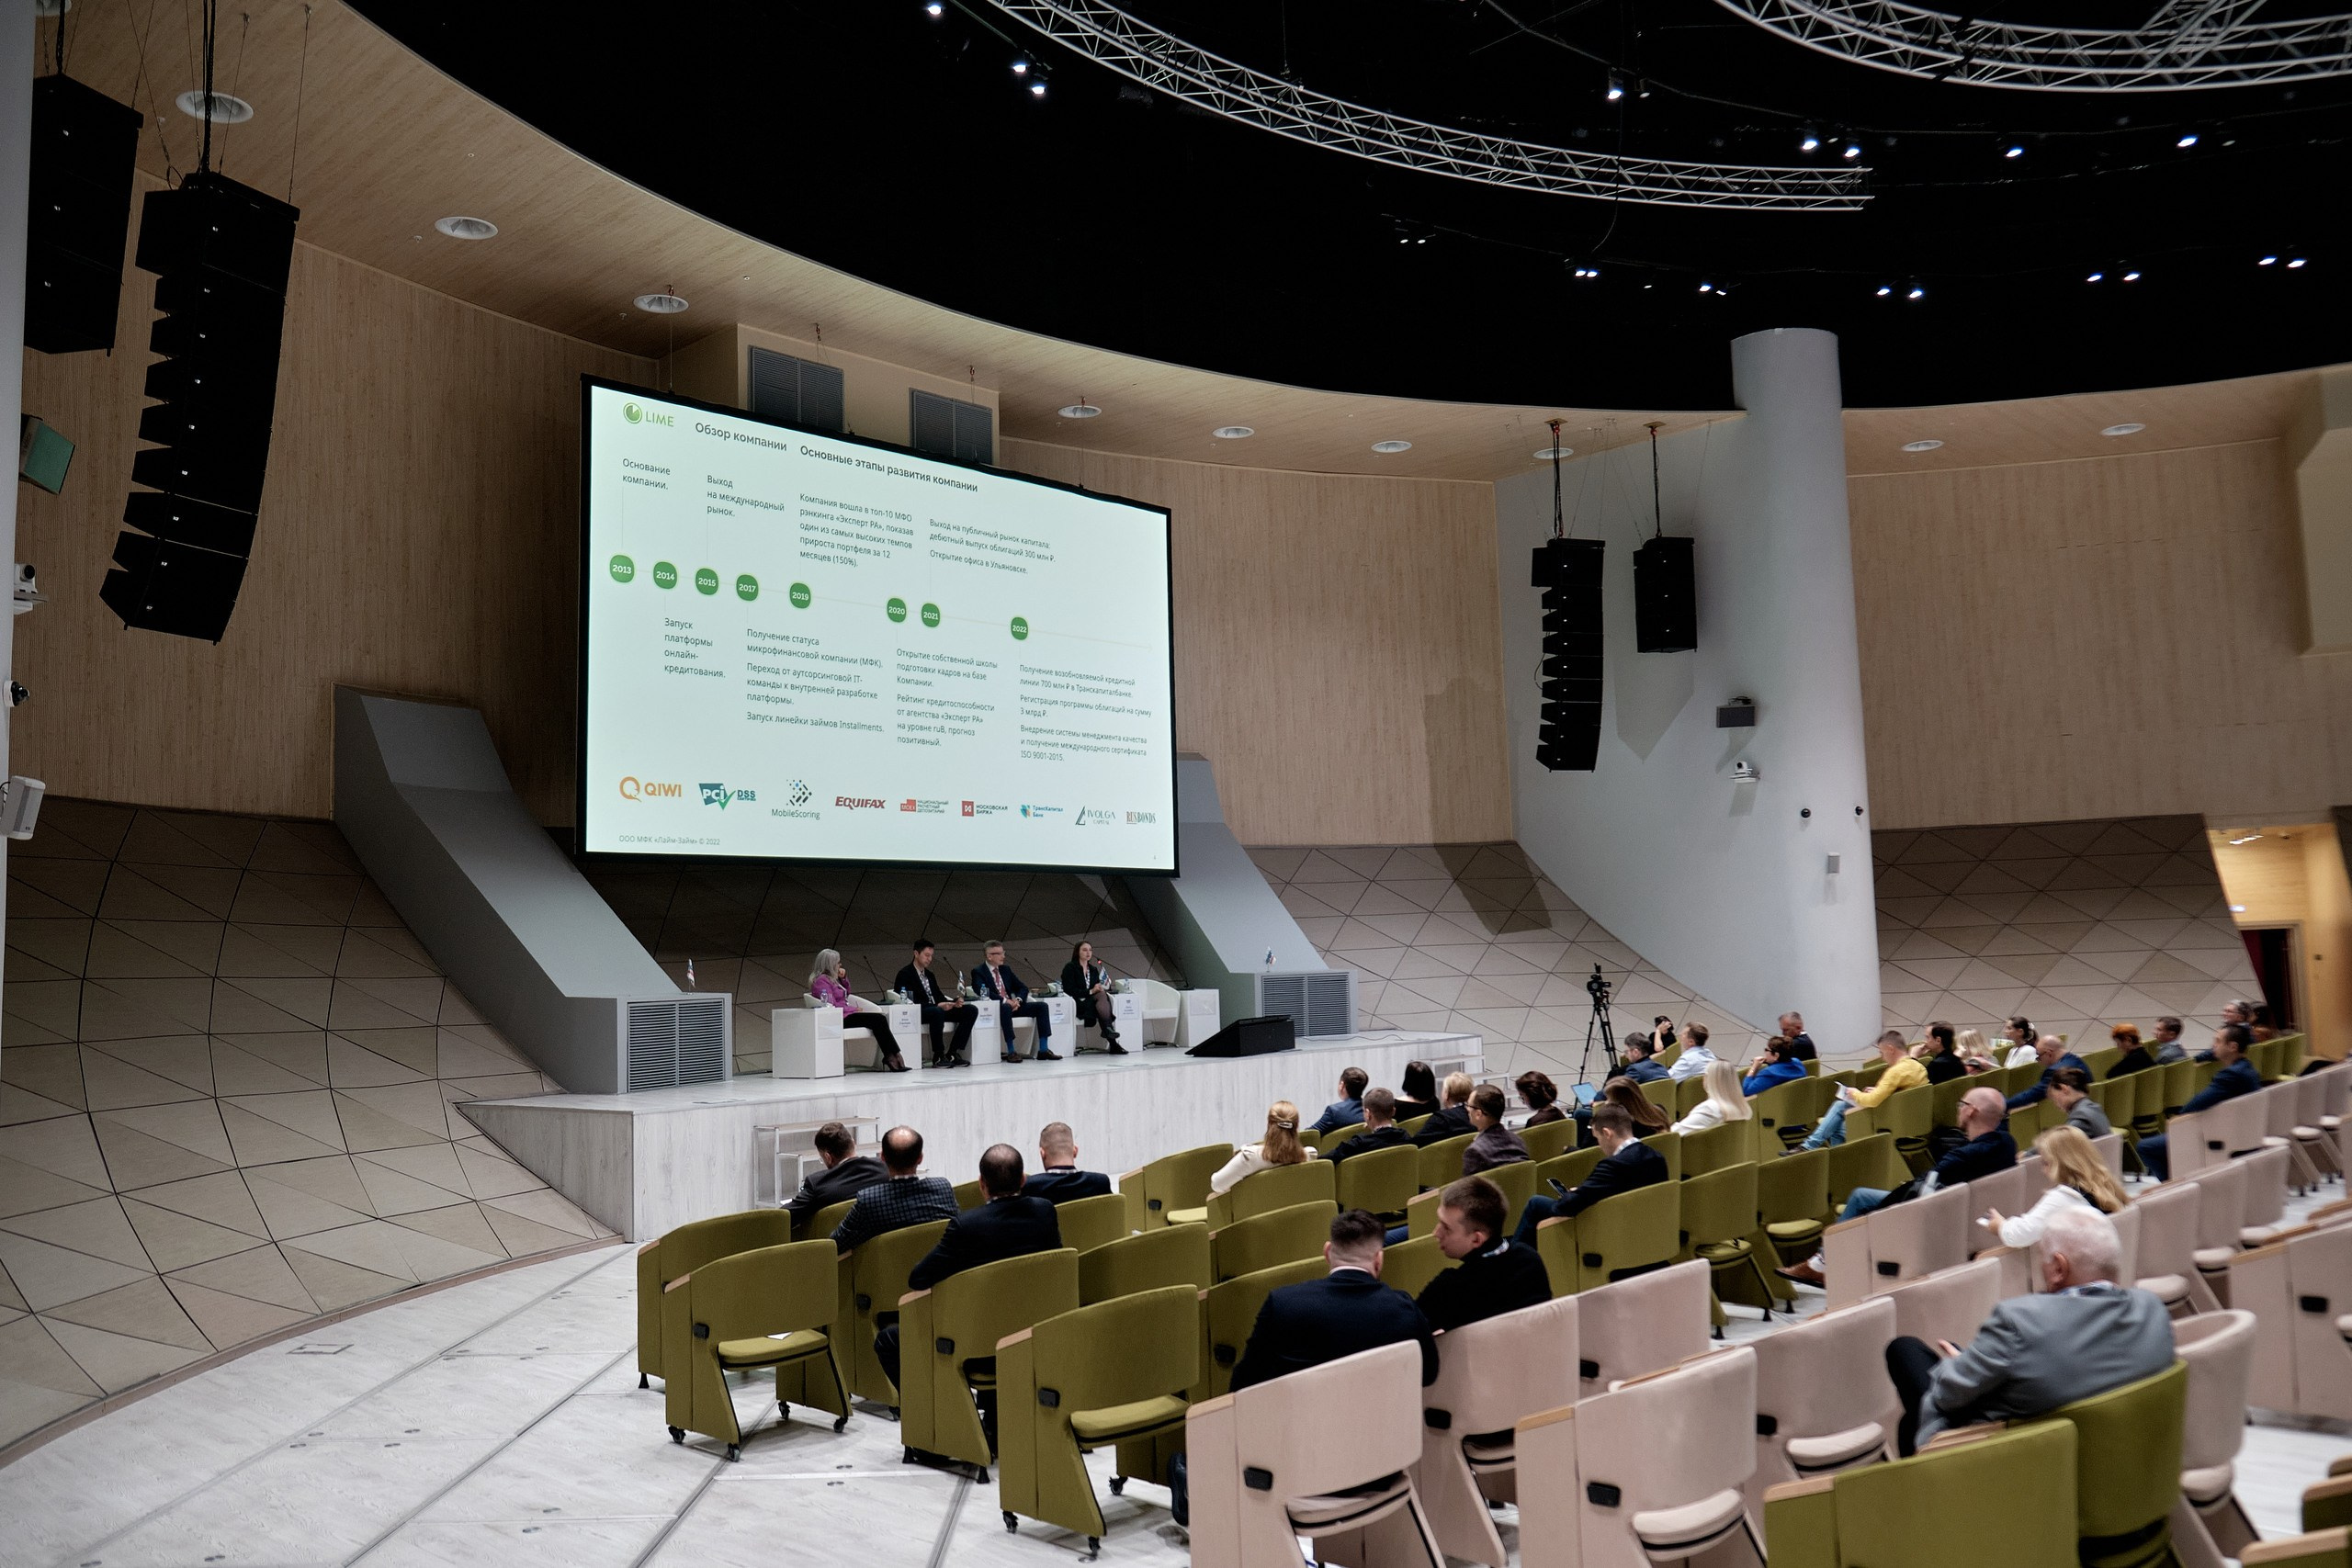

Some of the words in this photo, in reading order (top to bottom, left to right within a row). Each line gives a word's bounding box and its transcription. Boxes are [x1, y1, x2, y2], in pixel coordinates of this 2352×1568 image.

[646, 411, 674, 427] LIME
[695, 422, 731, 441] Обзор
[733, 432, 787, 451] компании
[622, 458, 670, 475] Основание
[800, 445, 853, 465] Основные
[855, 459, 885, 472] этапы
[887, 466, 931, 482] развития
[933, 476, 977, 492] компании
[622, 475, 668, 490] компании.
[707, 474, 733, 489] Выход
[719, 493, 784, 511] международный
[800, 493, 837, 507] Компания
[839, 502, 862, 512] вошла
[870, 508, 893, 518] топ-10
[894, 511, 912, 522] МФО
[707, 505, 735, 517] рынок.
[800, 508, 834, 521] рэнкинга
[835, 514, 868, 528] «Эксперт
[870, 520, 884, 531] РА»,
[886, 525, 914, 536] показав
[799, 522, 819, 532] один
[831, 528, 854, 538] самых
[855, 533, 885, 544] высоких
[887, 538, 912, 549] темпов
[929, 518, 951, 531] Выход
[961, 526, 998, 539] публичный
[999, 533, 1019, 542] рынок
[799, 536, 835, 549] прироста
[836, 543, 871, 555] портфеля
[882, 549, 890, 558] 12
[929, 533, 964, 545] дебютный
[965, 540, 988, 550] выпуск
[989, 543, 1023, 556] облигаций
[1024, 549, 1036, 558] 300
[799, 551, 831, 562] месяцев
[832, 555, 858, 567] (150%).
[929, 549, 962, 562] Открытие
[963, 556, 984, 566] офиса
[990, 560, 1028, 574] Ульяновске.
[612, 564, 631, 574] 2013
[656, 571, 674, 580] 2014
[698, 577, 716, 587] 2015
[739, 583, 756, 592] 2017
[792, 592, 809, 600] 2019
[889, 606, 905, 615] 2020
[923, 611, 938, 620] 2021
[664, 617, 693, 630] Запуск
[1012, 625, 1027, 633] 2022
[664, 634, 713, 647] платформы
[747, 628, 790, 642] Получение
[791, 636, 819, 647] статуса
[664, 649, 698, 659] онлайн-
[747, 644, 819, 659] микрофинансовой
[821, 654, 858, 664] компании
[859, 657, 883, 669] (МФК).
[896, 648, 930, 660] Открытие
[932, 653, 974, 665] собственной
[664, 665, 725, 678] кредитования.
[746, 662, 780, 675] Переход
[792, 669, 852, 682] аутсорсинговой
[853, 675, 862, 683] IT-
[896, 663, 936, 674] подготовки
[937, 669, 961, 677] кадров
[971, 671, 986, 680] базе
[1019, 664, 1053, 676] Получение
[1054, 670, 1104, 682] возобновляемой
[1105, 677, 1135, 686] кредитной
[897, 675, 934, 687] Компании.
[1041, 679, 1052, 688] 700
[1075, 684, 1133, 698] Транскапиталбанке.
[747, 679, 782, 690] команды
[790, 683, 835, 694] внутренней
[836, 688, 878, 699] разработке
[746, 693, 794, 705] платформы.
[897, 693, 925, 703] Рейтинг
[926, 699, 994, 711] кредитоспособности
[1020, 694, 1058, 706] Регистрация
[1059, 700, 1094, 710] программы
[1094, 703, 1125, 713] облигаций
[1134, 709, 1151, 718] сумму
[906, 709, 939, 719] агентства
[941, 712, 971, 723] «Эксперт
[971, 715, 983, 723] РА»
[1025, 709, 1042, 717] млрд
[746, 711, 773, 723] Запуск
[774, 716, 808, 725] линейки
[810, 718, 838, 728] займов
[839, 720, 884, 732] Installments.
[907, 724, 932, 732] уровне
[933, 725, 946, 734] ruB,
[948, 727, 975, 736] прогноз
[1020, 724, 1054, 735] Внедрение
[1055, 729, 1081, 737] системы
[1081, 732, 1121, 741] менеджмента
[897, 736, 941, 746] позитивный.
[1026, 739, 1059, 748] получение
[1060, 742, 1110, 752] международного
[1111, 747, 1146, 756] сертификата
[1021, 750, 1032, 758] ISO
[1032, 751, 1064, 761] 9001-2015.
[644, 782, 682, 797] QIWI
[835, 796, 886, 810] EQUIFAX
[771, 808, 820, 820] MobileScoring
[1087, 810, 1116, 819] IVOLGA
